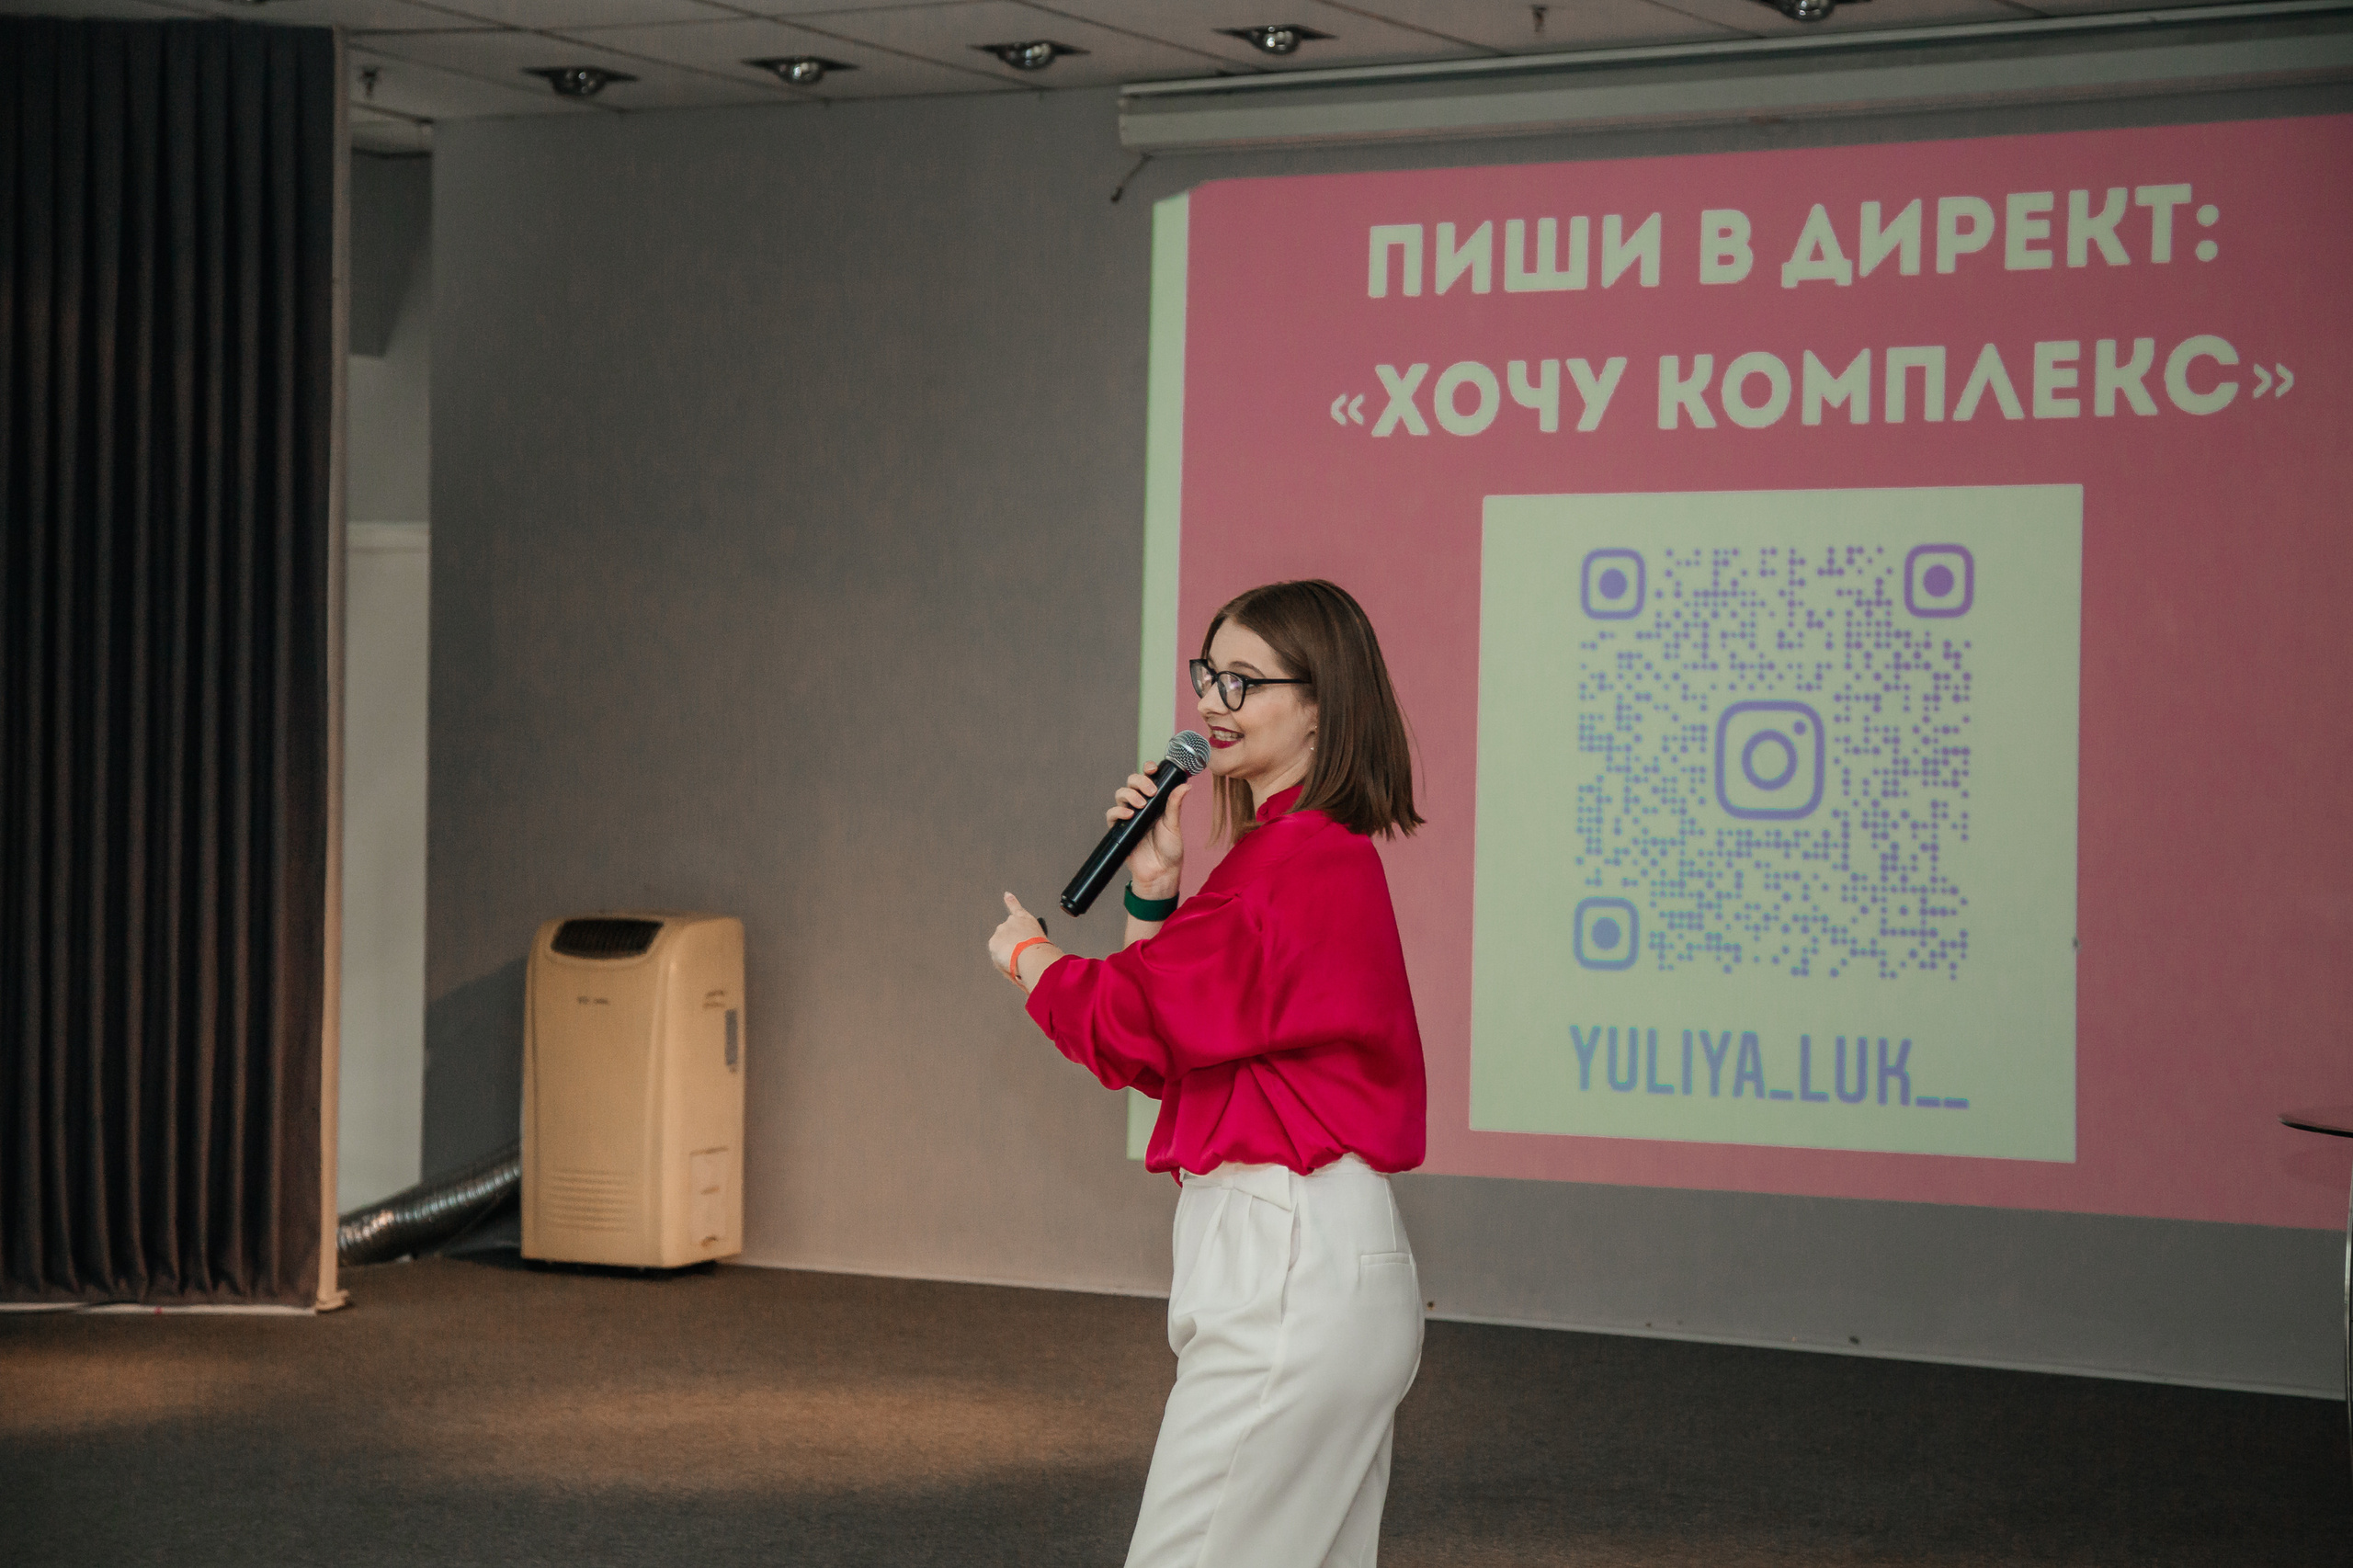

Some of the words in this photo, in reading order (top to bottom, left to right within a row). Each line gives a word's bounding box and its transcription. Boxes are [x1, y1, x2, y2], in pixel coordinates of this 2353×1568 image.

[1368, 212, 1662, 298] ПИШИ
[1699, 210, 1754, 285] В
[1781, 184, 2220, 289] ДИРЕКТ:
[1330, 357, 1628, 437] «ХОЧУ
[1658, 335, 2295, 429] КОМПЛЕКС»
